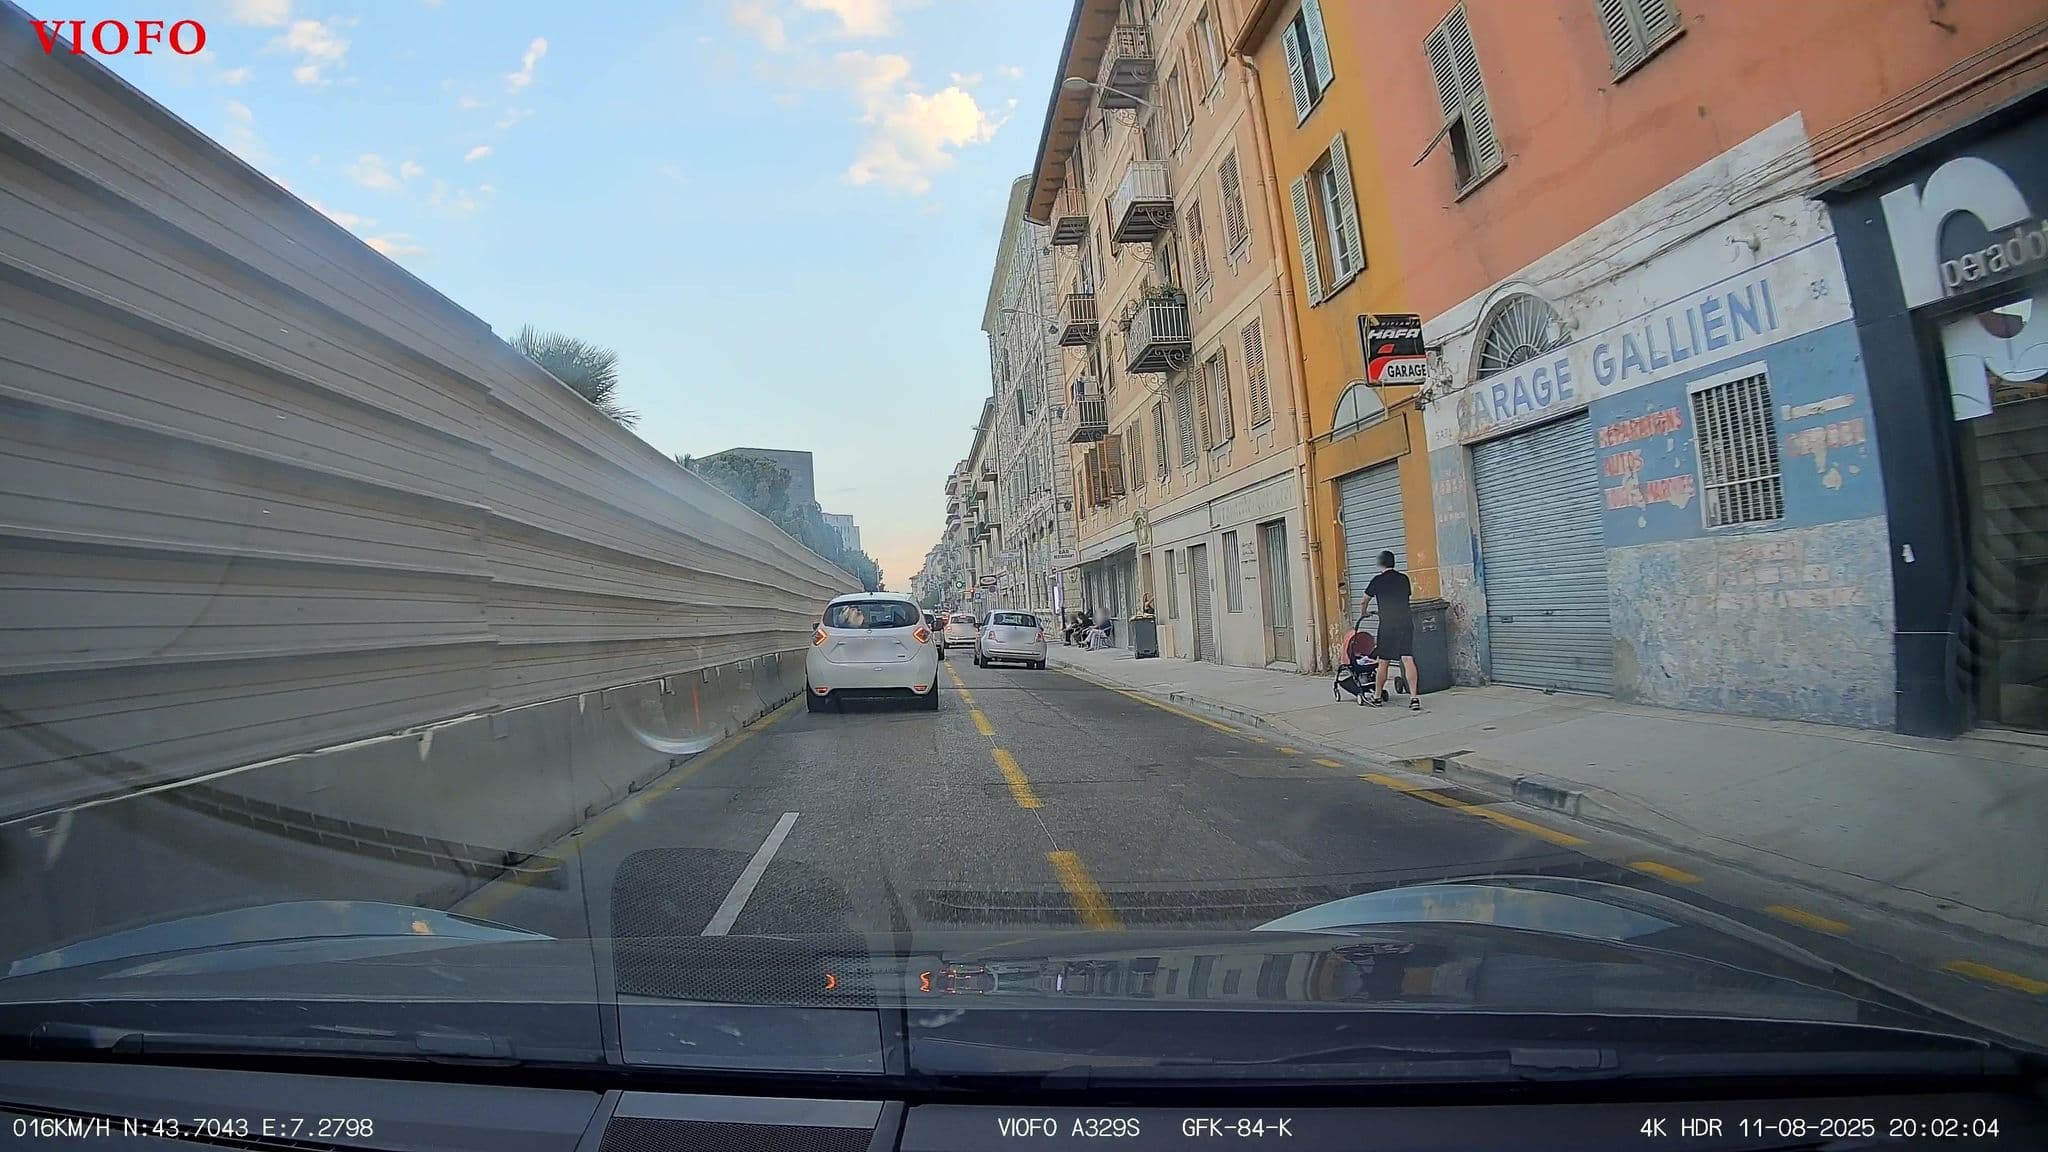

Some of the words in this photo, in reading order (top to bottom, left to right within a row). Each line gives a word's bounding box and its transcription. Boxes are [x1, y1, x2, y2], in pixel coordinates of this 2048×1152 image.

[1367, 328, 1421, 339] HAFA
[1387, 364, 1427, 378] GARAGE
[1460, 357, 1575, 428] ARAGE
